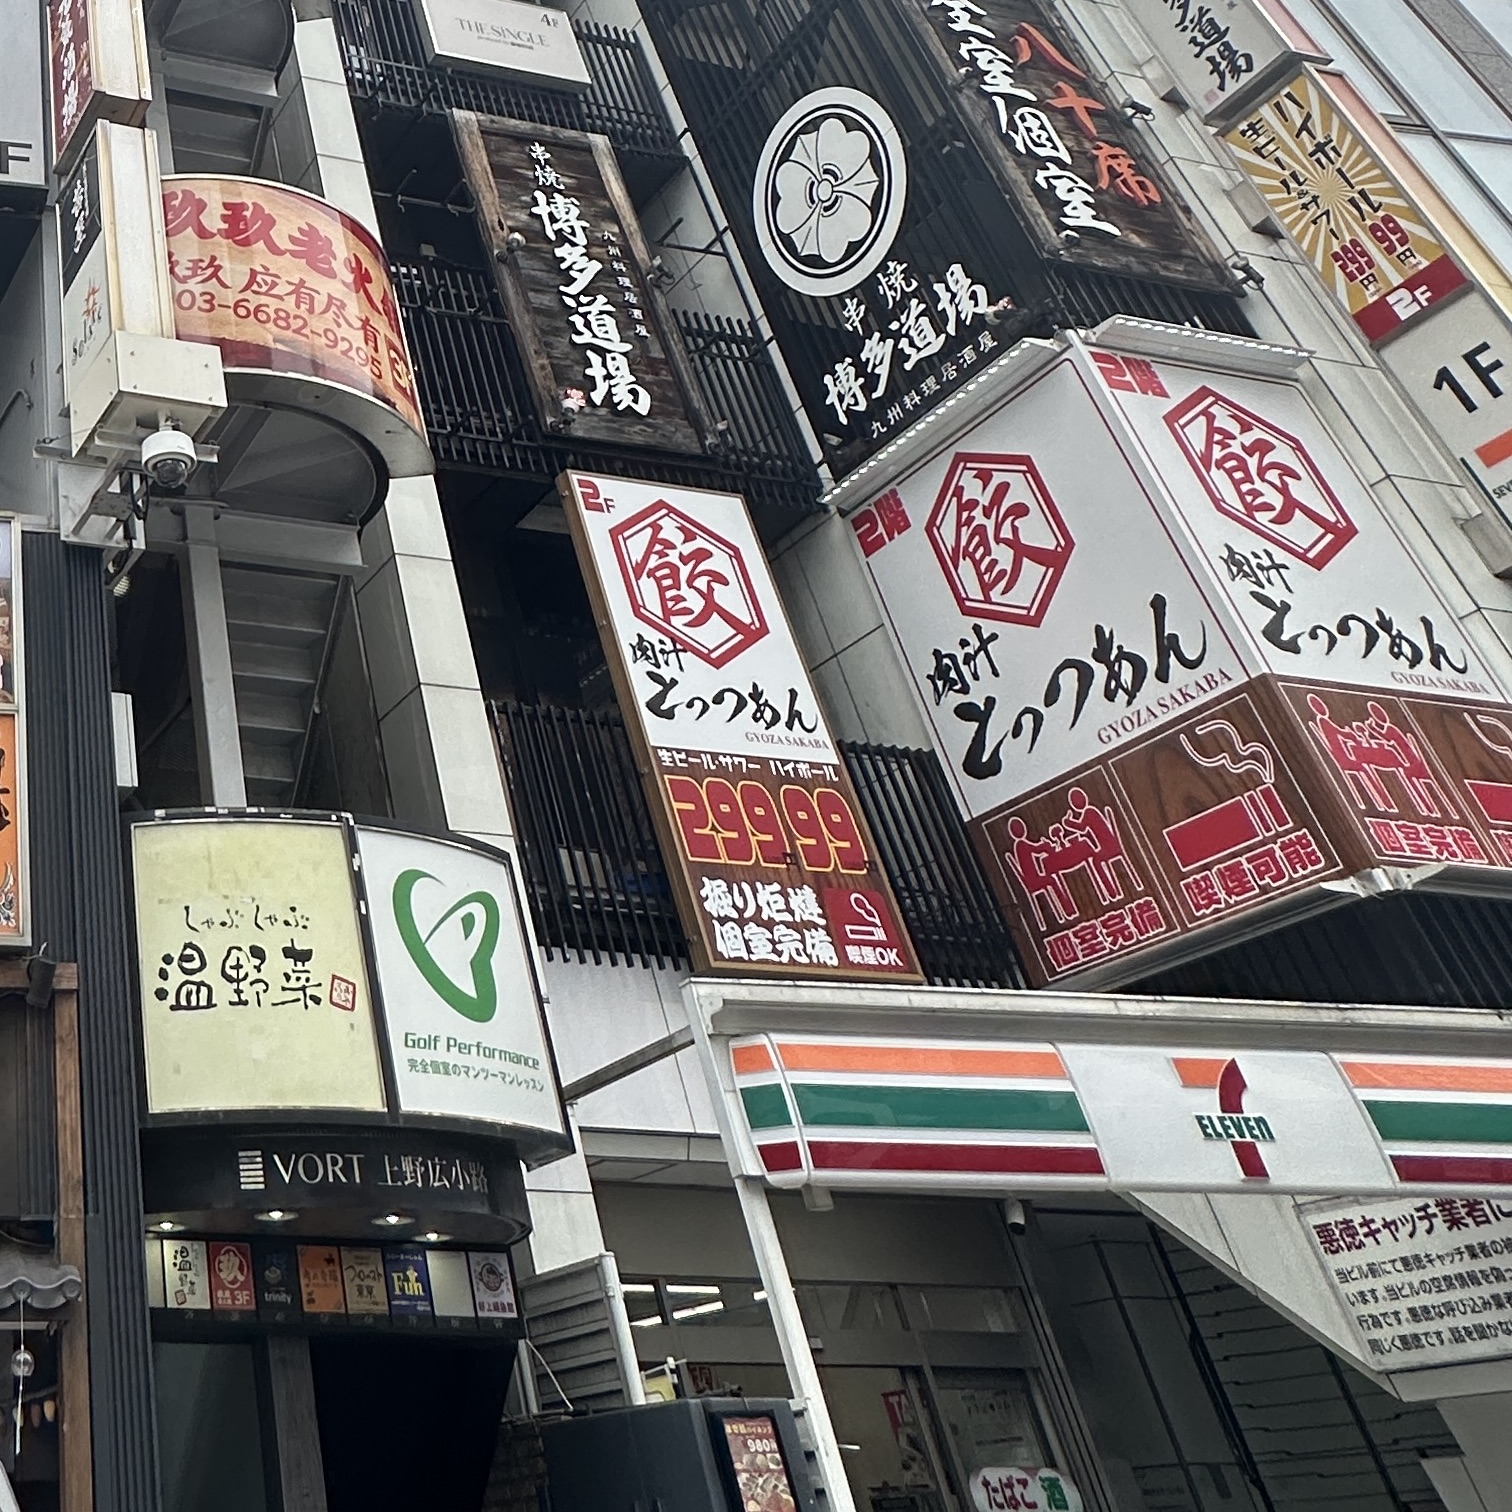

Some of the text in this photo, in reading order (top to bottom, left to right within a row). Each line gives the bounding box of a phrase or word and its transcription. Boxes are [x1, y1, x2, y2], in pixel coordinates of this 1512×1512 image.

[1011, 21, 1162, 207] 八十席
[529, 141, 566, 191] 串焼
[1274, 89, 1383, 223] ハイボール
[530, 190, 651, 416] 博多道場
[842, 260, 922, 334] 串焼
[1385, 284, 1433, 321] 2F
[175, 288, 384, 381] 03-6682-9295
[823, 263, 989, 426] 博多道場
[870, 331, 999, 440] 九州料理居酒屋
[1431, 340, 1506, 414] 1F
[577, 478, 617, 516] 2F
[1096, 666, 1234, 748] GYOZA SAKABA
[657, 748, 840, 782] 生ビール・サワー ハイボール
[744, 731, 830, 751] GYOZA SAKABA
[663, 774, 869, 875] 299 99
[1366, 817, 1488, 864] 個室完備
[1179, 828, 1325, 917] 喫煙可能
[184, 904, 311, 933] しゃぶしゃぶ
[699, 876, 827, 926] 掘り炬燵
[711, 919, 840, 967] 個室完備
[844, 943, 904, 968] 喫煙OK
[1048, 898, 1165, 970] 個室完備
[154, 938, 323, 1011] 温野菜
[404, 1031, 541, 1071] Golf Performance
[272, 1152, 489, 1193] VORT 上野広小路
[233, 1289, 251, 1306] 3F
[263, 1290, 293, 1305] trinity
[391, 1271, 425, 1297] Fun
[980, 1474, 1039, 1512] たばこ
[1039, 1474, 1072, 1512] 酒
